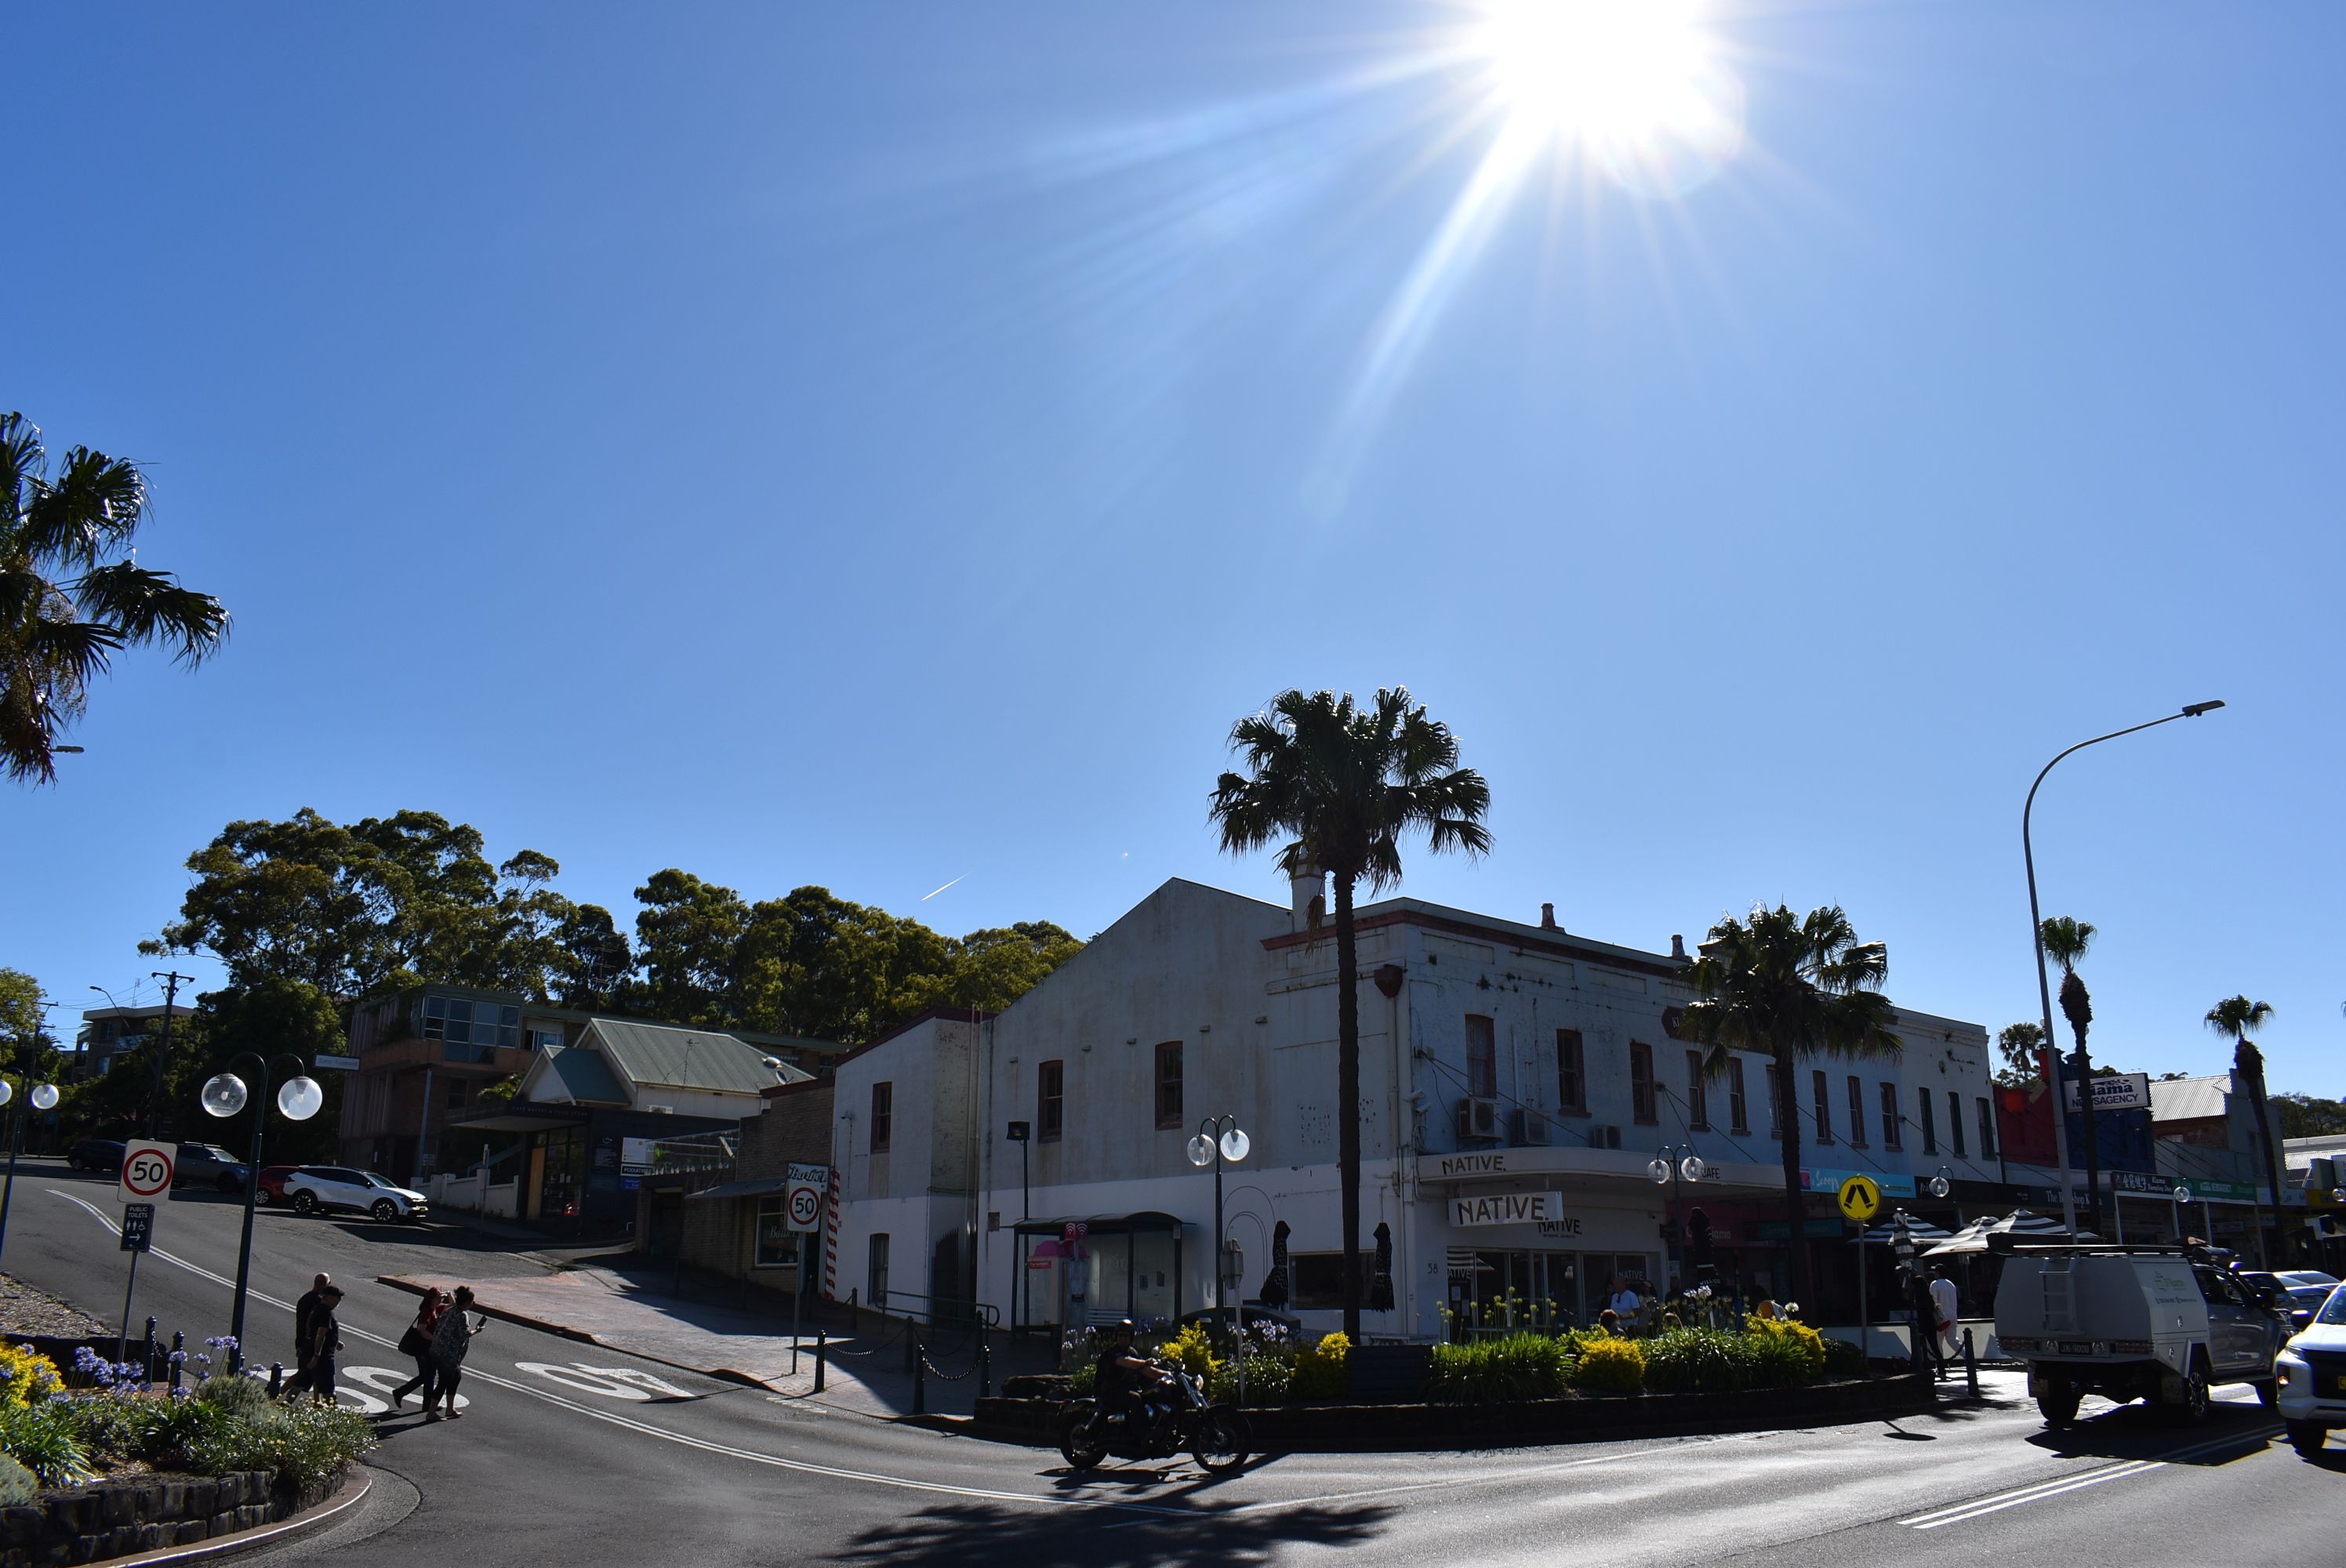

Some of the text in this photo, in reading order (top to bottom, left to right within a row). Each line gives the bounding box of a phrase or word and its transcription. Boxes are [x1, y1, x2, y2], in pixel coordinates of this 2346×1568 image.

[2072, 1094, 2138, 1107] NESAGENCY
[133, 1161, 163, 1182] 50
[795, 1197, 814, 1214] 50
[1458, 1196, 1549, 1225] NATIVE.
[1428, 1262, 1438, 1274] 58
